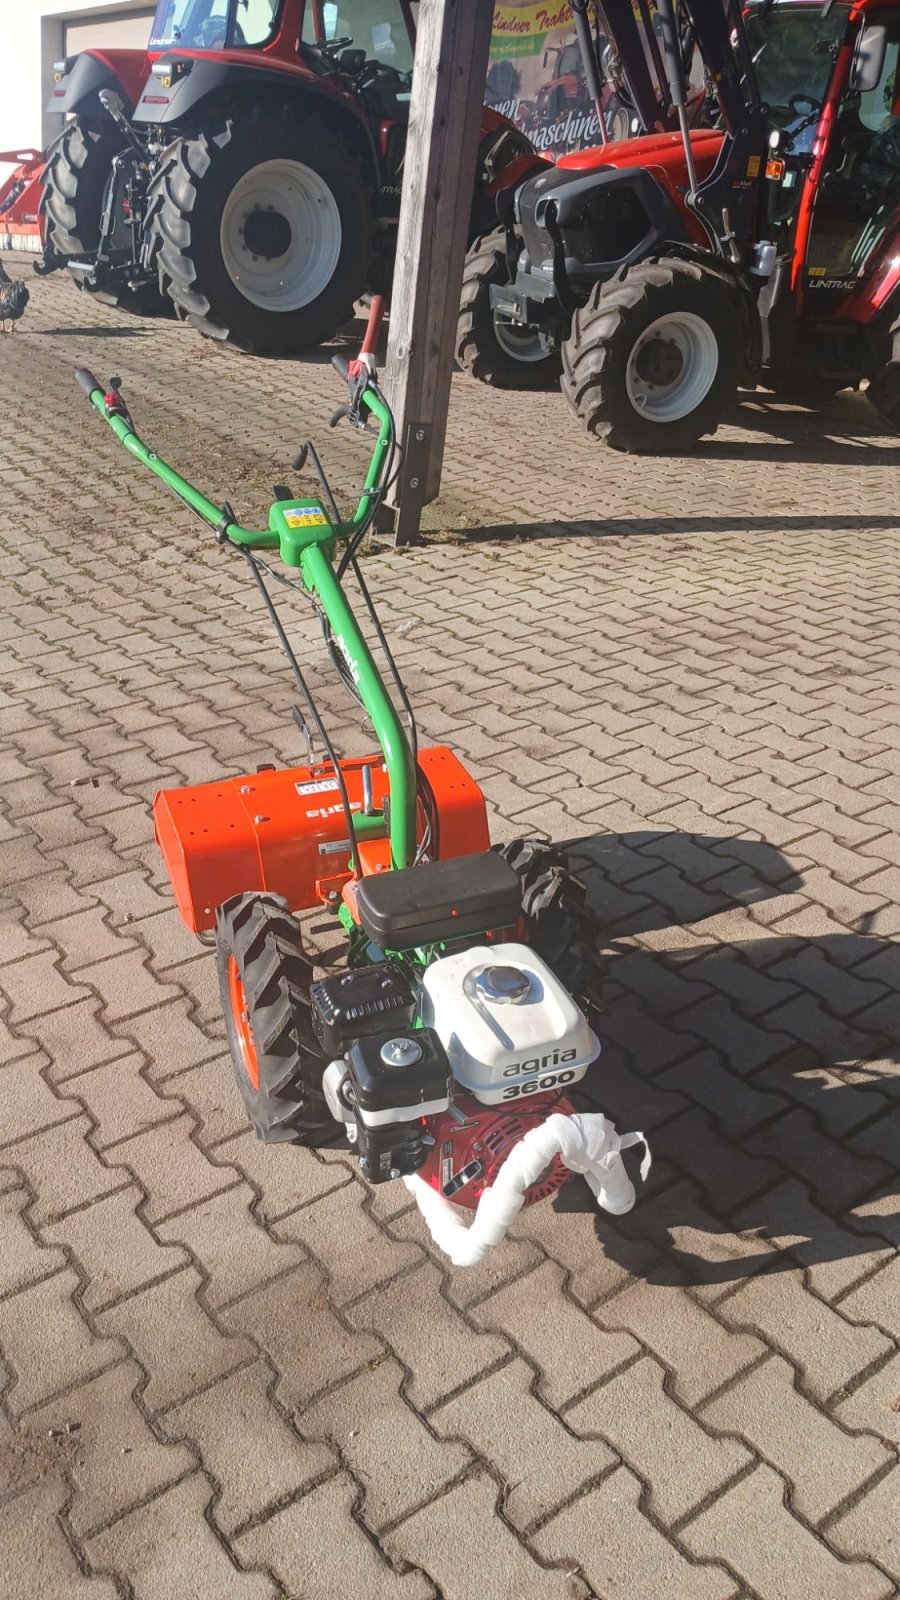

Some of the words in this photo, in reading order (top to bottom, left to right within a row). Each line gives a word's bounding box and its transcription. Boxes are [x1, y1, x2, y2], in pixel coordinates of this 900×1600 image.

[521, 108, 613, 150] maschinen
[808, 279, 857, 289] LINTRAC
[502, 1048, 577, 1077] agria
[502, 1070, 575, 1100] 3600
